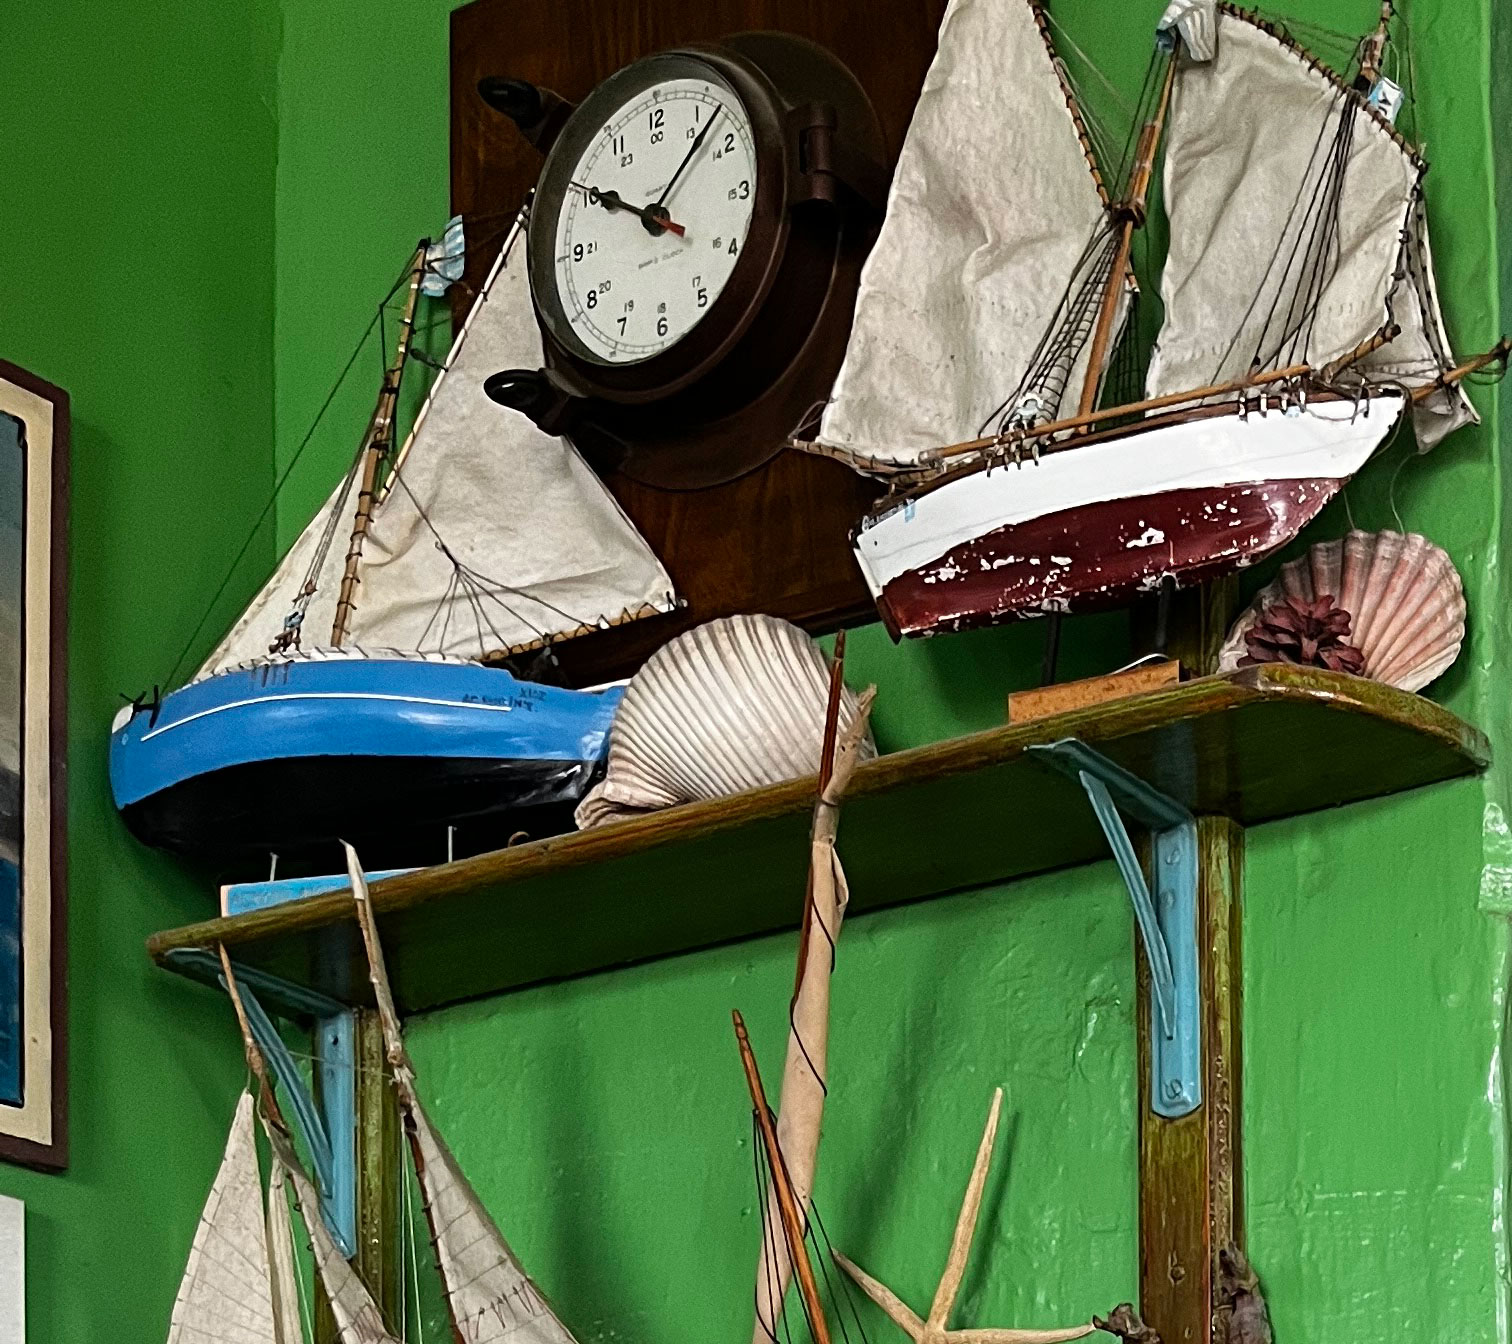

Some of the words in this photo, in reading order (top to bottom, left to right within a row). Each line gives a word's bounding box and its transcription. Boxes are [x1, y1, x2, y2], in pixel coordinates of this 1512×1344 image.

[649, 108, 665, 131] 12
[695, 105, 700, 123] 1
[613, 135, 625, 155] 11
[650, 131, 664, 144] 00
[724, 133, 736, 154] 2
[620, 153, 634, 168] 23
[712, 149, 723, 161] 14
[738, 180, 750, 200] 3
[573, 243, 584, 263] 9
[587, 241, 598, 254] 21
[728, 237, 739, 257] 4
[598, 280, 612, 294] 20
[692, 275, 702, 288] 17
[586, 290, 597, 310] 8
[624, 300, 634, 312] 19
[697, 288, 708, 308] 5
[657, 302, 667, 314] 18
[616, 317, 627, 336] 7
[657, 317, 668, 336] 6
